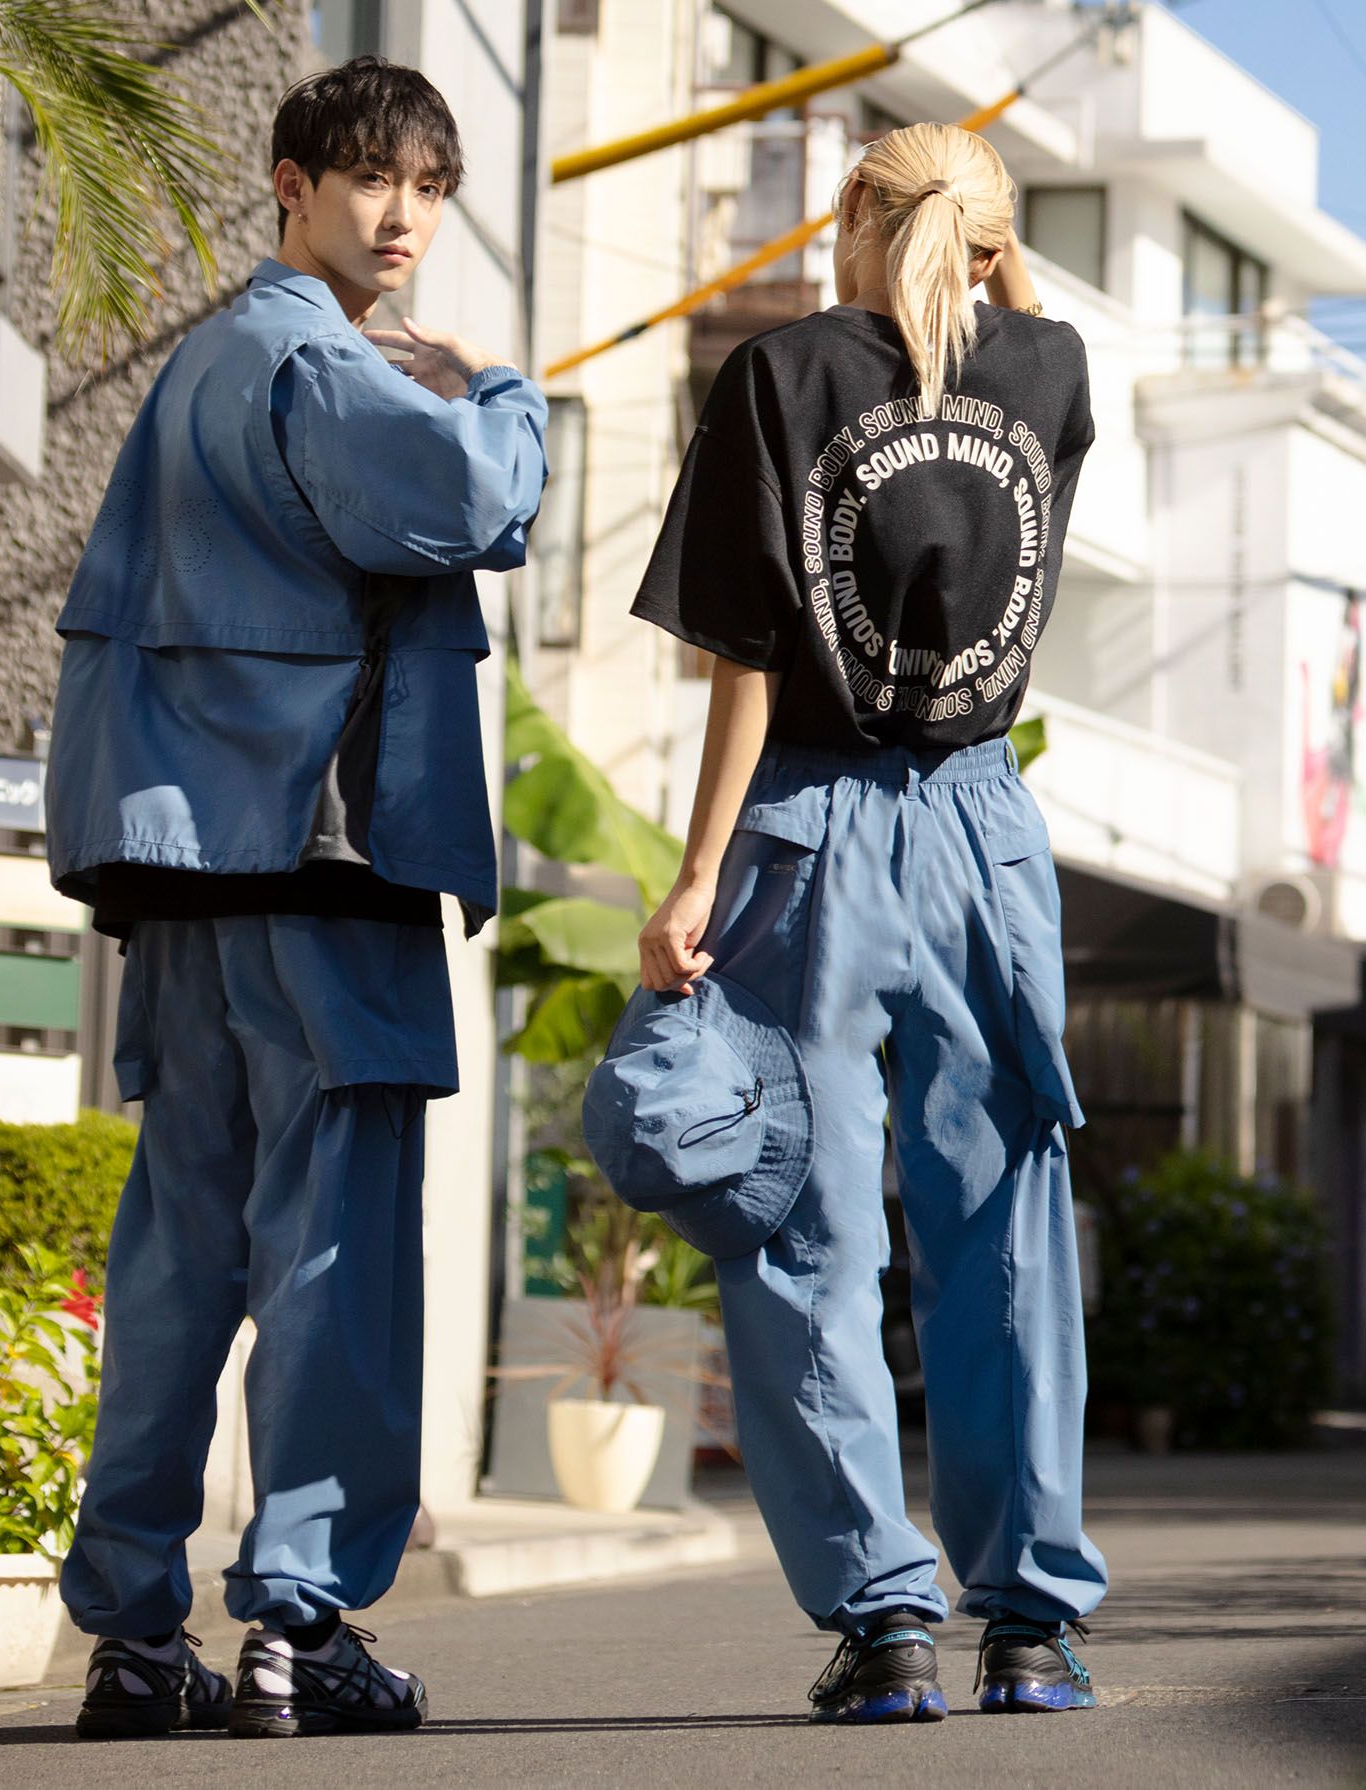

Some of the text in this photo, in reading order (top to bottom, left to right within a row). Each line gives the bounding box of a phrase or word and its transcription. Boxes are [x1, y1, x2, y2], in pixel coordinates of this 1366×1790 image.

[941, 394, 1004, 440] MIND,
[808, 426, 866, 493] BODY.
[856, 433, 940, 490] SOUND
[947, 432, 1014, 488] MIND,
[1008, 420, 1052, 494] SOUND
[802, 490, 825, 574] SOUND
[829, 488, 868, 562] BODY.
[1013, 477, 1038, 567] SOUND
[810, 578, 841, 652] MIND,
[832, 570, 884, 658] SOUND
[992, 575, 1033, 648] BODY.
[1021, 568, 1044, 650] SOUND
[917, 687, 974, 722] SOUN
[975, 644, 1027, 703] MIND,
